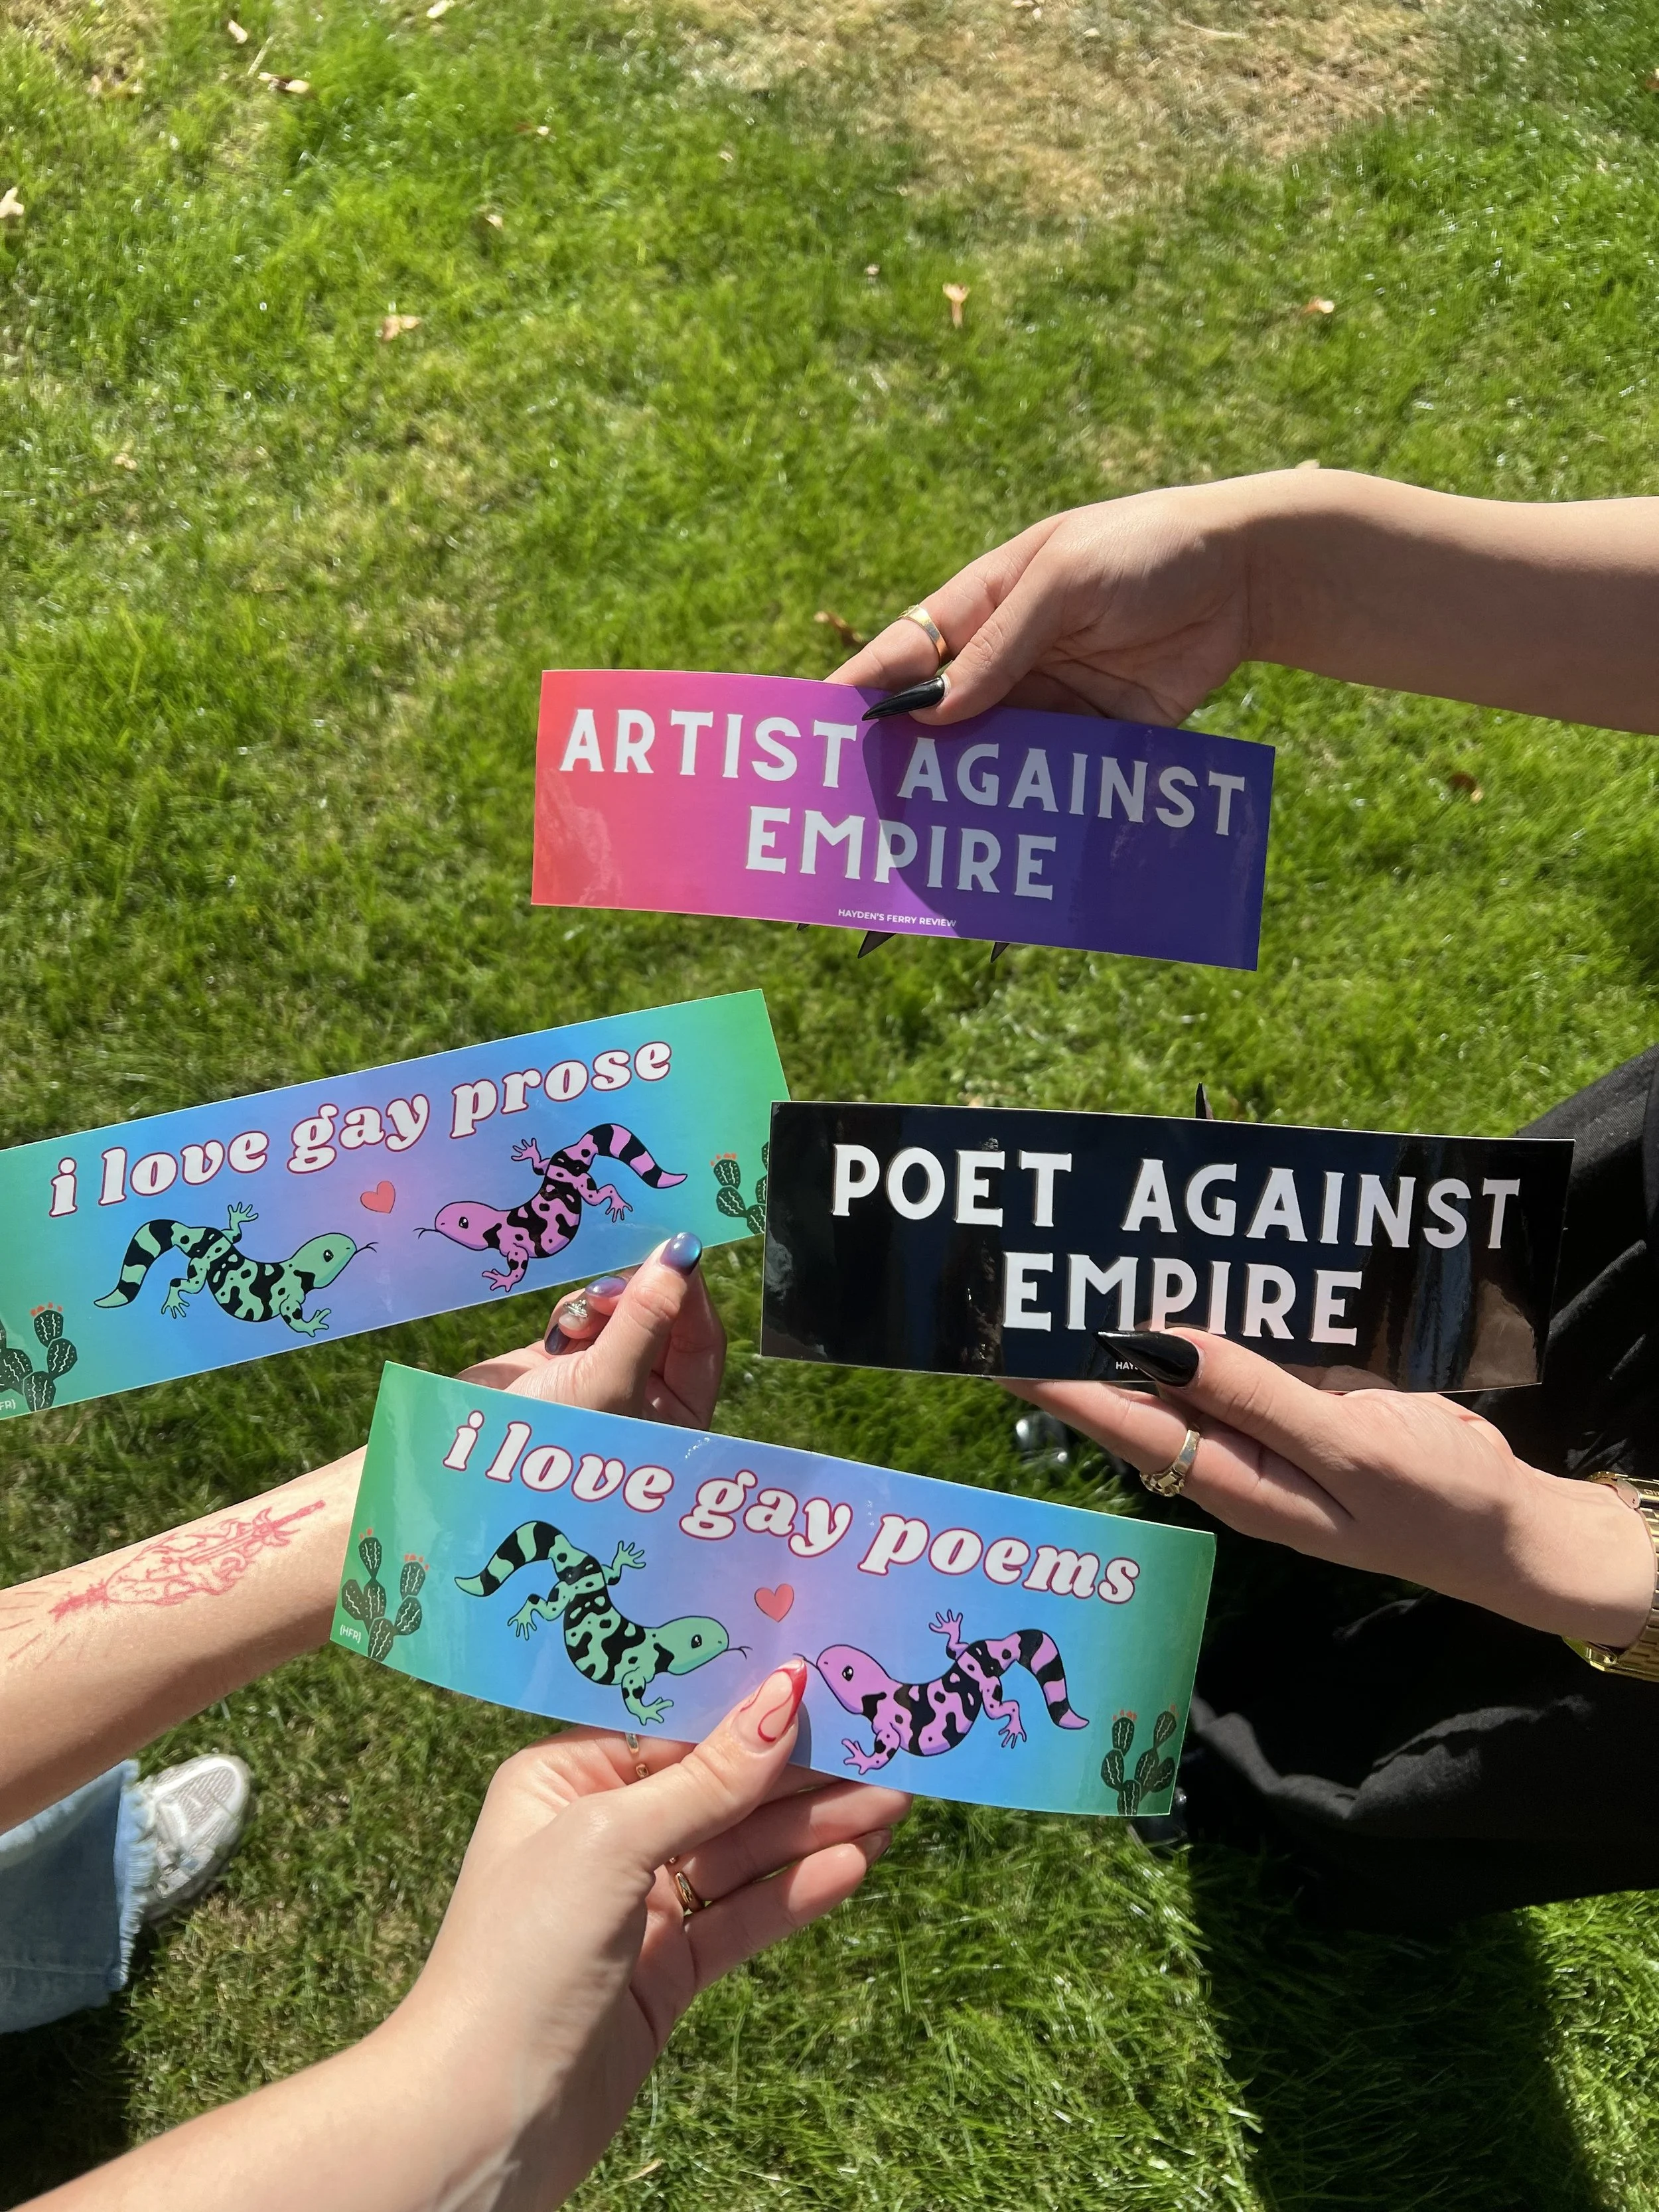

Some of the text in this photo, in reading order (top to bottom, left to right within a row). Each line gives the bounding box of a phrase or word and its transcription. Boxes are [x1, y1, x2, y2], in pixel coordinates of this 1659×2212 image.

[559, 707, 1246, 836] ARTIST AGAINST
[743, 804, 1058, 901] EMPIRE
[838, 909, 956, 927] HAYDEN'S FERRY REVIEW
[49, 1041, 672, 1217] i love gay prose
[831, 1143, 1521, 1250] POET AGAINST
[1002, 1251, 1363, 1347] EMPIRE
[442, 1410, 1141, 1604] i love gay poems
[340, 1624, 362, 1644] (HFR)
